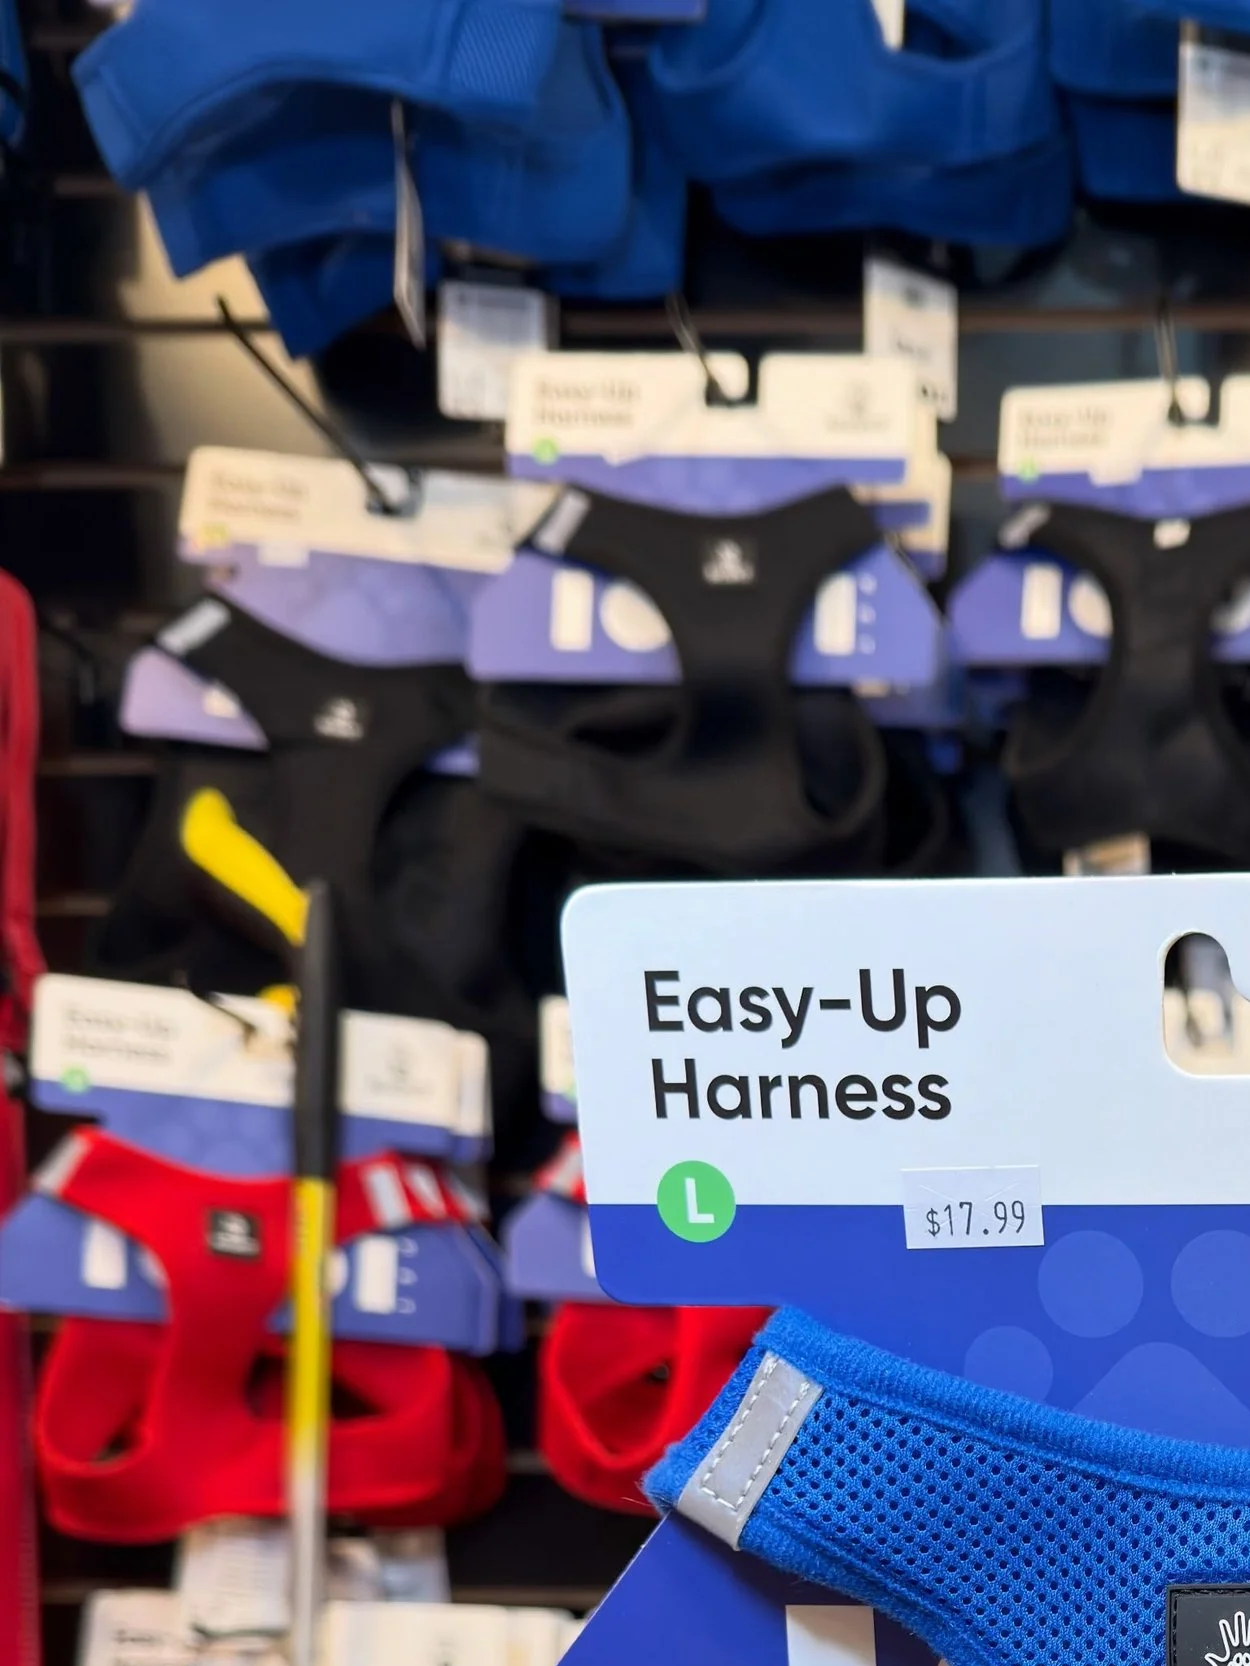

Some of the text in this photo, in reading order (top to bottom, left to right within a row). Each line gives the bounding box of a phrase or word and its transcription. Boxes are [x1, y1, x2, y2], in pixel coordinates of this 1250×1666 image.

[643, 968, 962, 1049] Easy-Up
[651, 1058, 952, 1120] Harness
[685, 1177, 715, 1224] L
[926, 1200, 1026, 1237] $17.99
